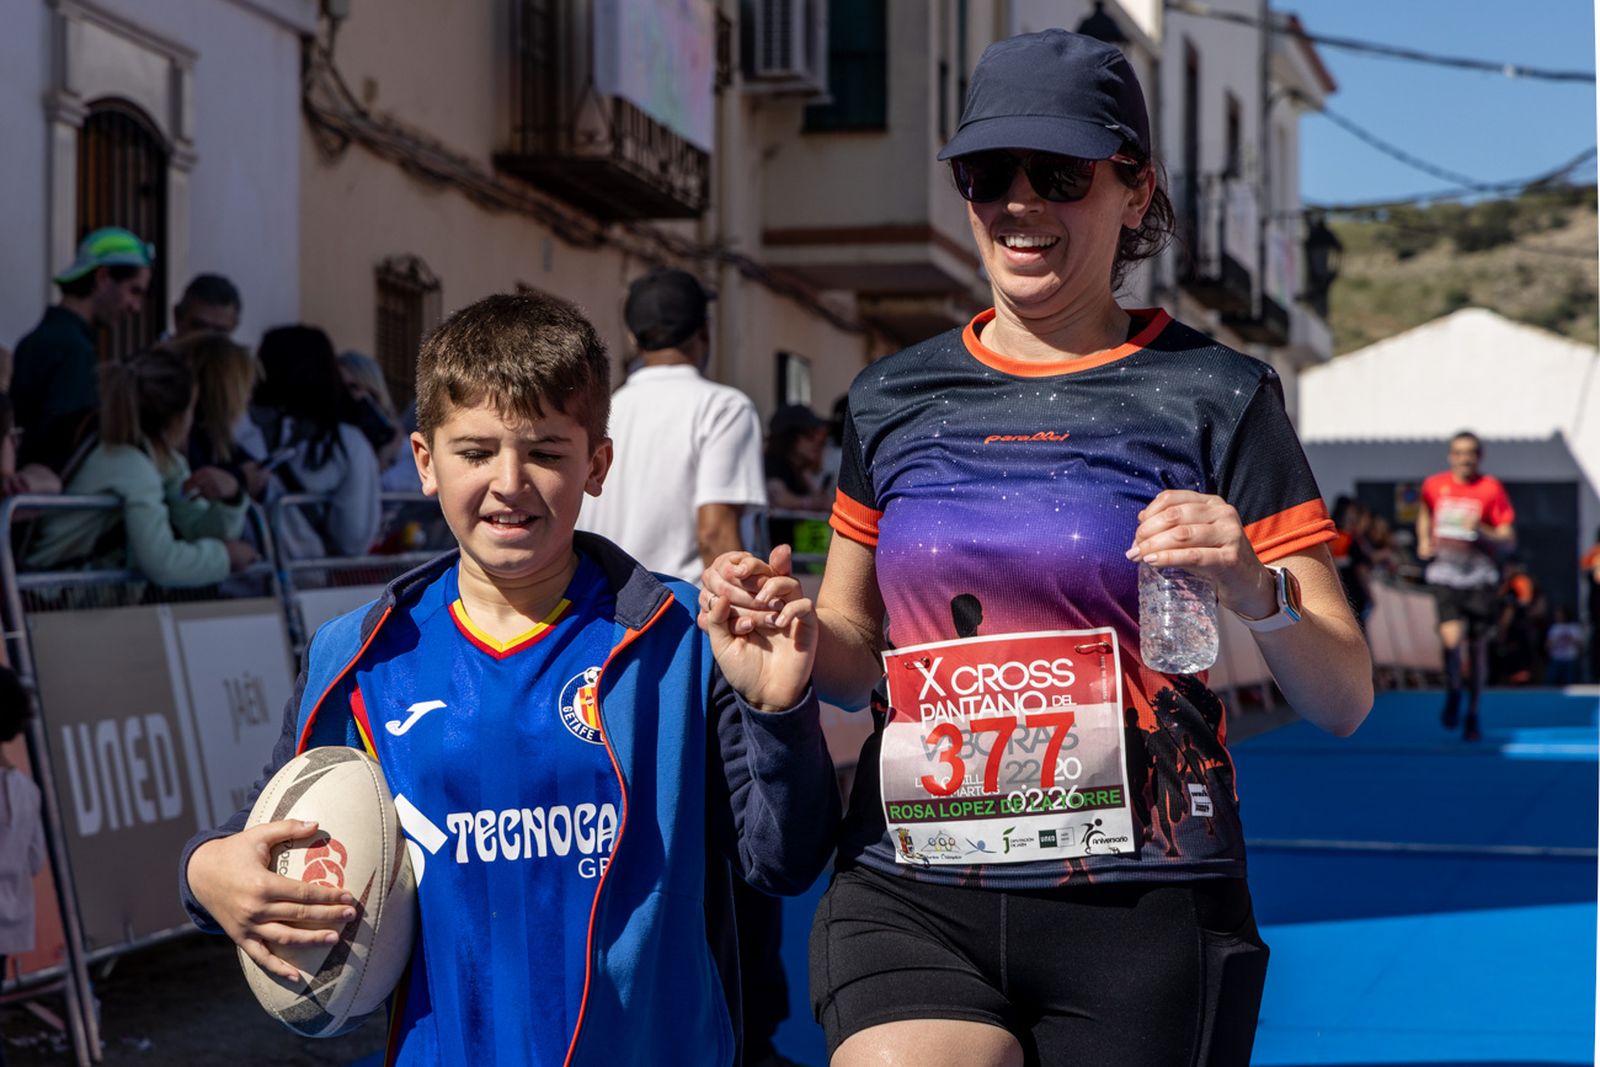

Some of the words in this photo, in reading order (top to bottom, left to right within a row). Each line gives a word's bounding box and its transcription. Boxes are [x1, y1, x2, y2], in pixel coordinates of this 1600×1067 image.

[913, 657, 947, 700] X
[951, 658, 1076, 696] CROSS
[562, 705, 596, 741] GETAFE
[919, 690, 1048, 729] PANTANO
[1052, 694, 1078, 708] DEL
[920, 722, 1080, 762] VBORAS
[920, 711, 1076, 796] 377
[61, 712, 184, 837] UNED
[889, 801, 937, 820] ROSA
[939, 799, 996, 818] LOPEZ
[1000, 797, 1025, 813] DE
